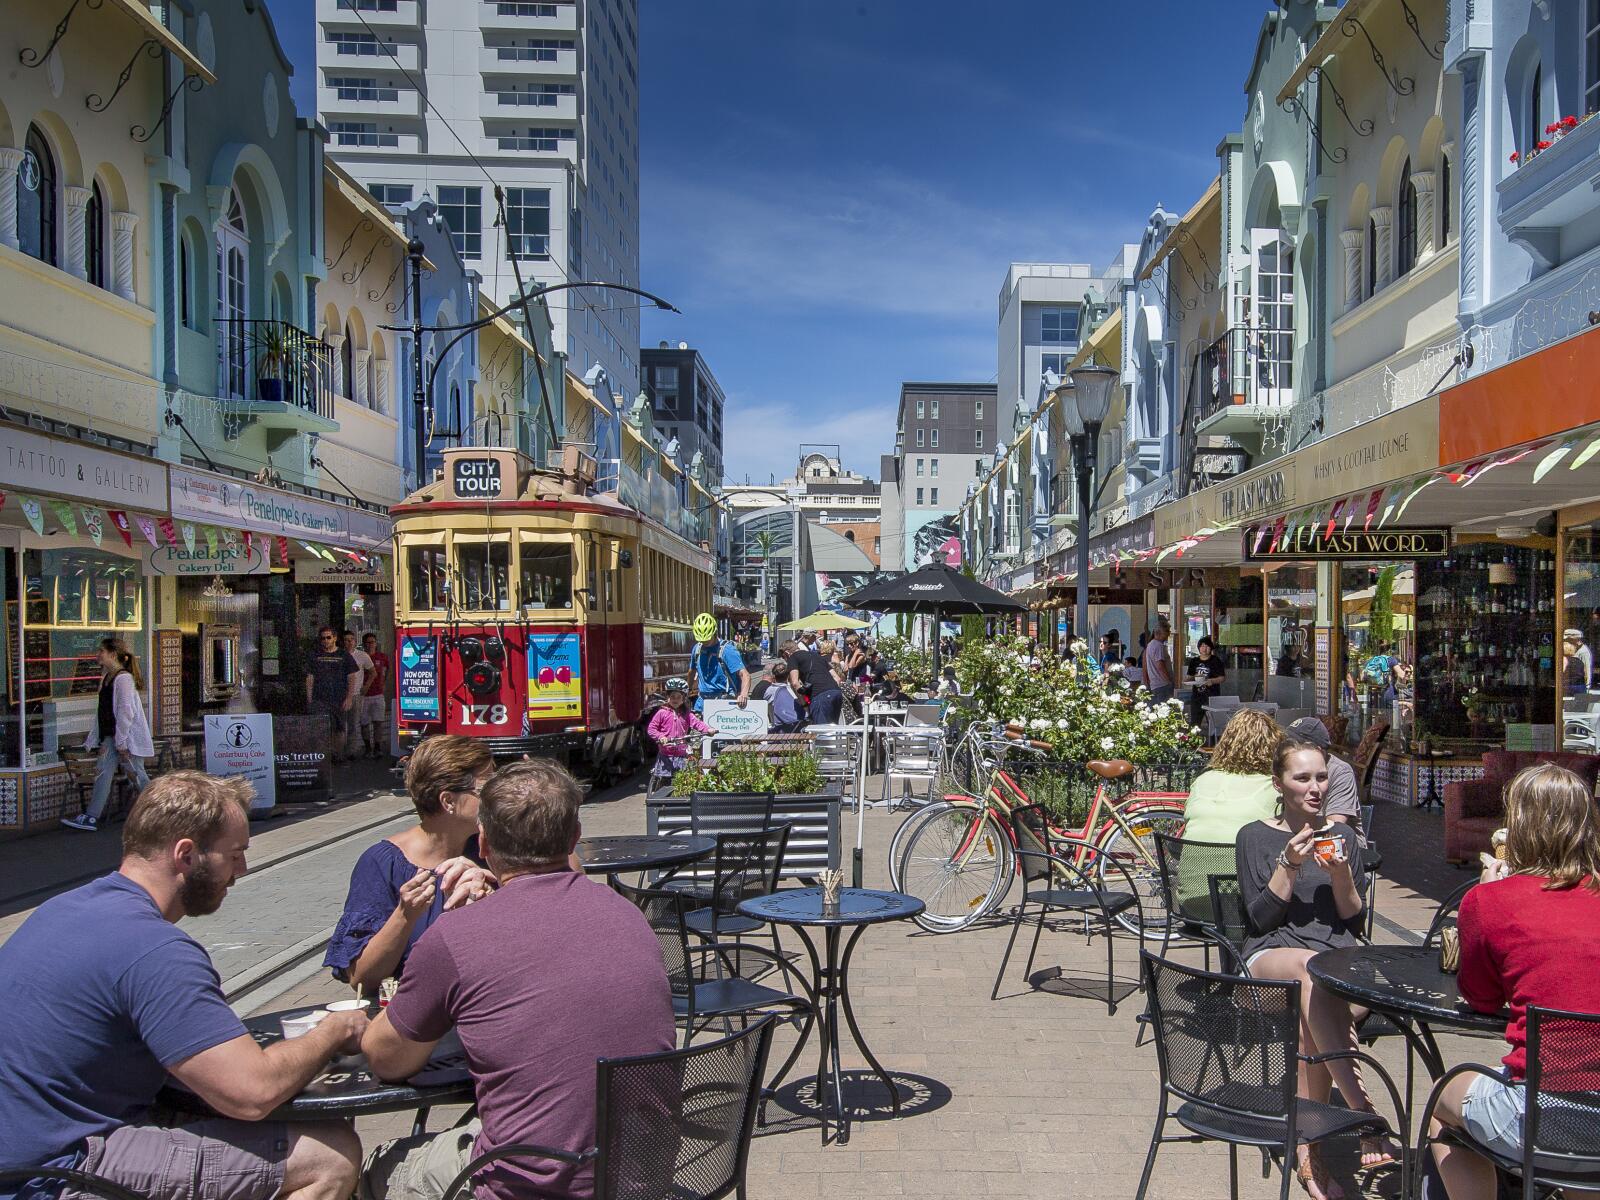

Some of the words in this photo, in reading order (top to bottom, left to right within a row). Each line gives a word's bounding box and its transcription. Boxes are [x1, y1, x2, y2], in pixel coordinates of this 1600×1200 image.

[1344, 445, 1377, 470] COCKTAIL
[1378, 432, 1409, 460] LOUNGE
[7, 446, 66, 478] TATTOO
[77, 463, 85, 482] &
[95, 466, 150, 495] GALLERY
[460, 462, 496, 475] CITY
[456, 477, 501, 491] TOUR
[1236, 481, 1255, 513] LAST
[246, 493, 300, 532] Penelope's
[302, 513, 324, 534] Cakery
[325, 517, 338, 533] Deli
[1316, 535, 1362, 553] LAST
[1365, 535, 1429, 553] WORD.
[178, 563, 212, 574] Cakery
[214, 563, 235, 572] Deli
[408, 686, 430, 694] CENTRE
[461, 704, 509, 725] 178
[716, 715, 759, 726] Penelope's
